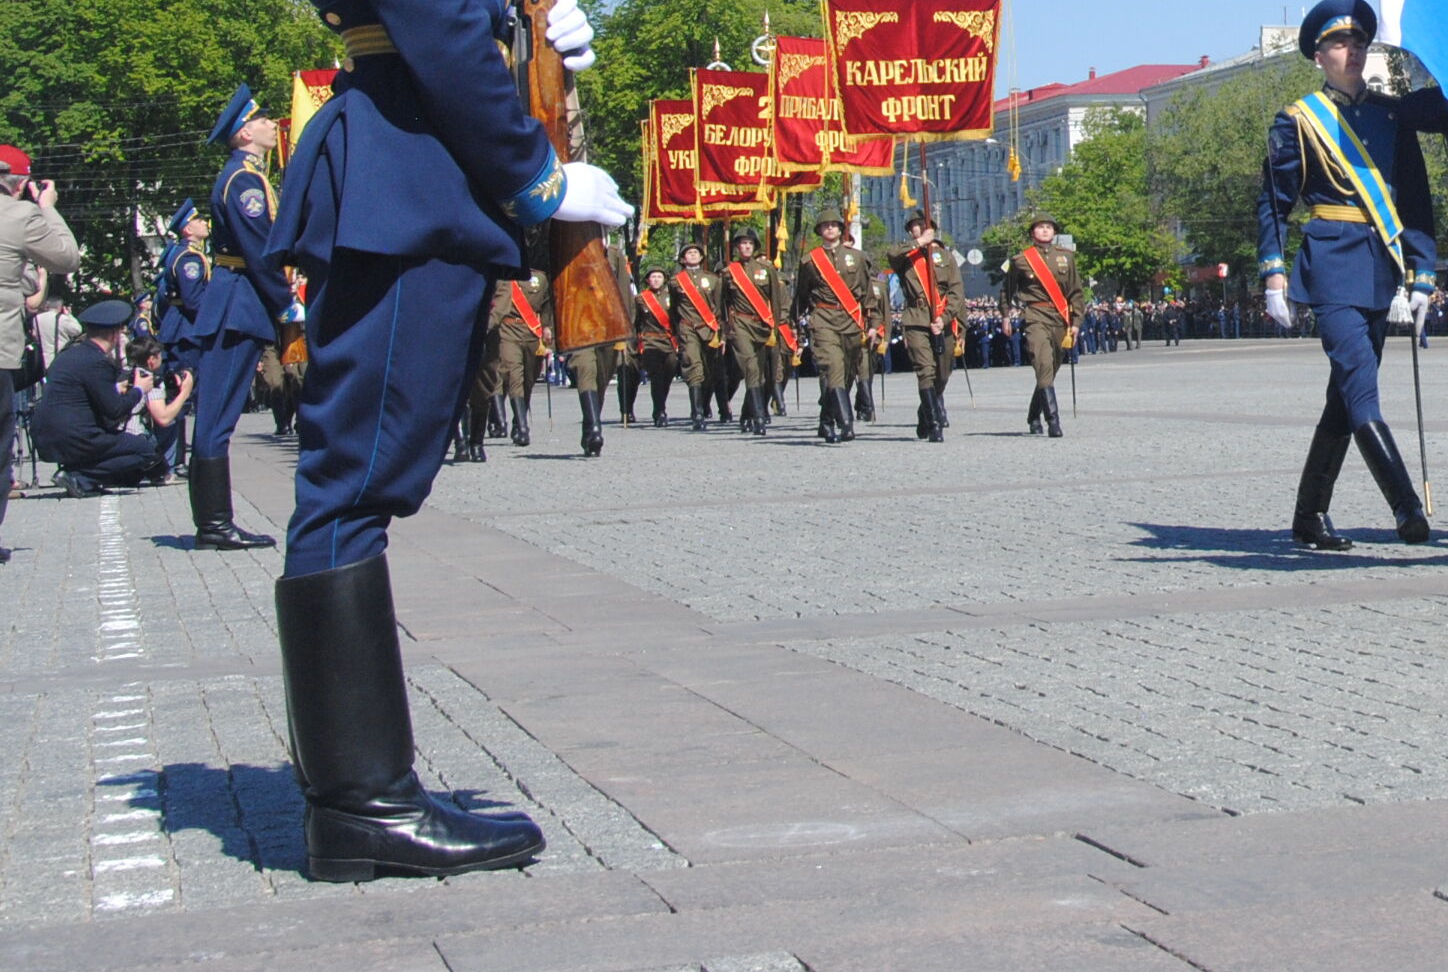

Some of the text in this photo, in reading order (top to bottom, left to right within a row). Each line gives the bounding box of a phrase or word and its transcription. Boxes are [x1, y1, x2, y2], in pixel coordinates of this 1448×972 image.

[845, 51, 988, 87] КАРЕЛЬСКИЙ
[779, 95, 840, 121] ПРИБАЛ
[881, 94, 956, 123] ФРОНТ
[704, 124, 774, 148] БЕЛОРУ
